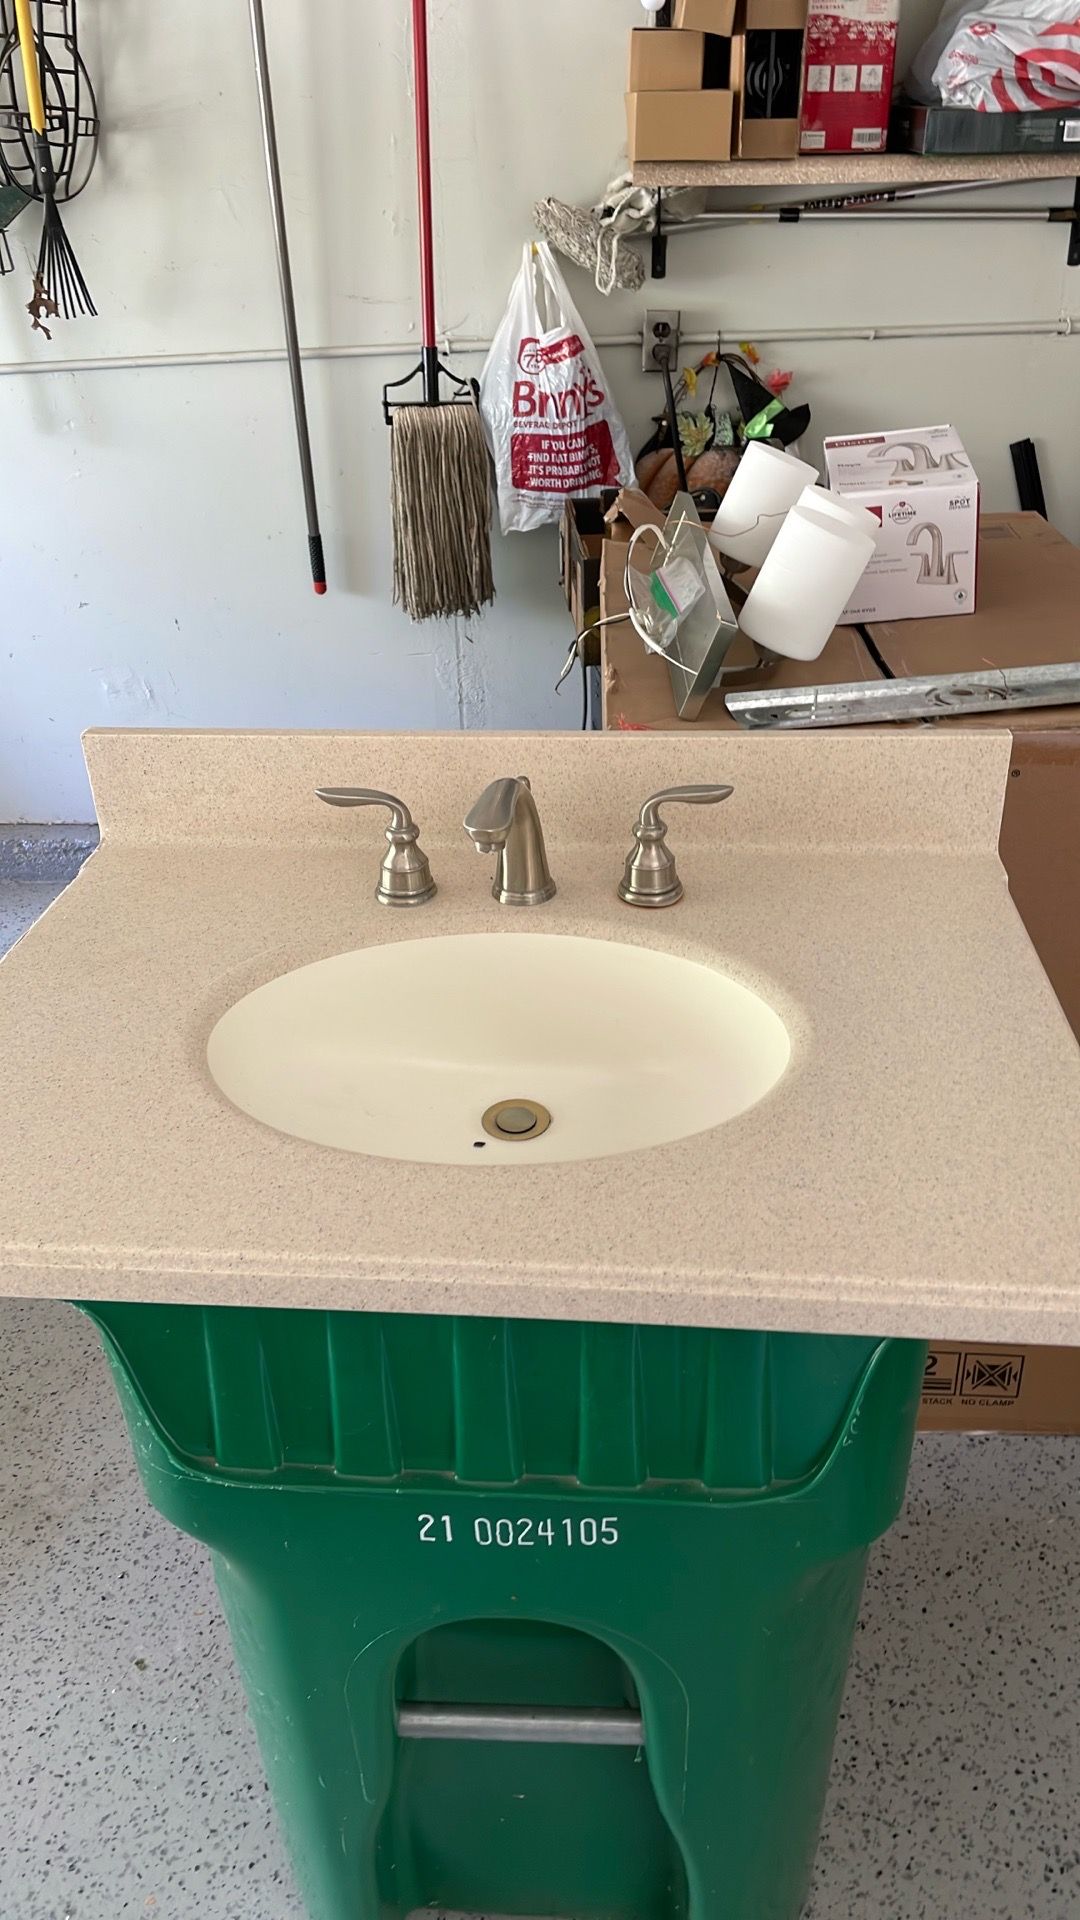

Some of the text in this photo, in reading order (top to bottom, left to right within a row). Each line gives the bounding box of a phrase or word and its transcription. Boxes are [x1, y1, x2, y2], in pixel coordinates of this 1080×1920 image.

[541, 440, 550, 450] IF
[528, 452, 550, 463] FIND
[530, 477, 562, 489] WORTH
[949, 498, 971, 507] SPOT
[888, 510, 917, 518] LIFETIME
[925, 1355, 938, 1376] 2
[978, 1399, 1015, 1407] CLAMP
[417, 1513, 619, 1547] 21 0024105
